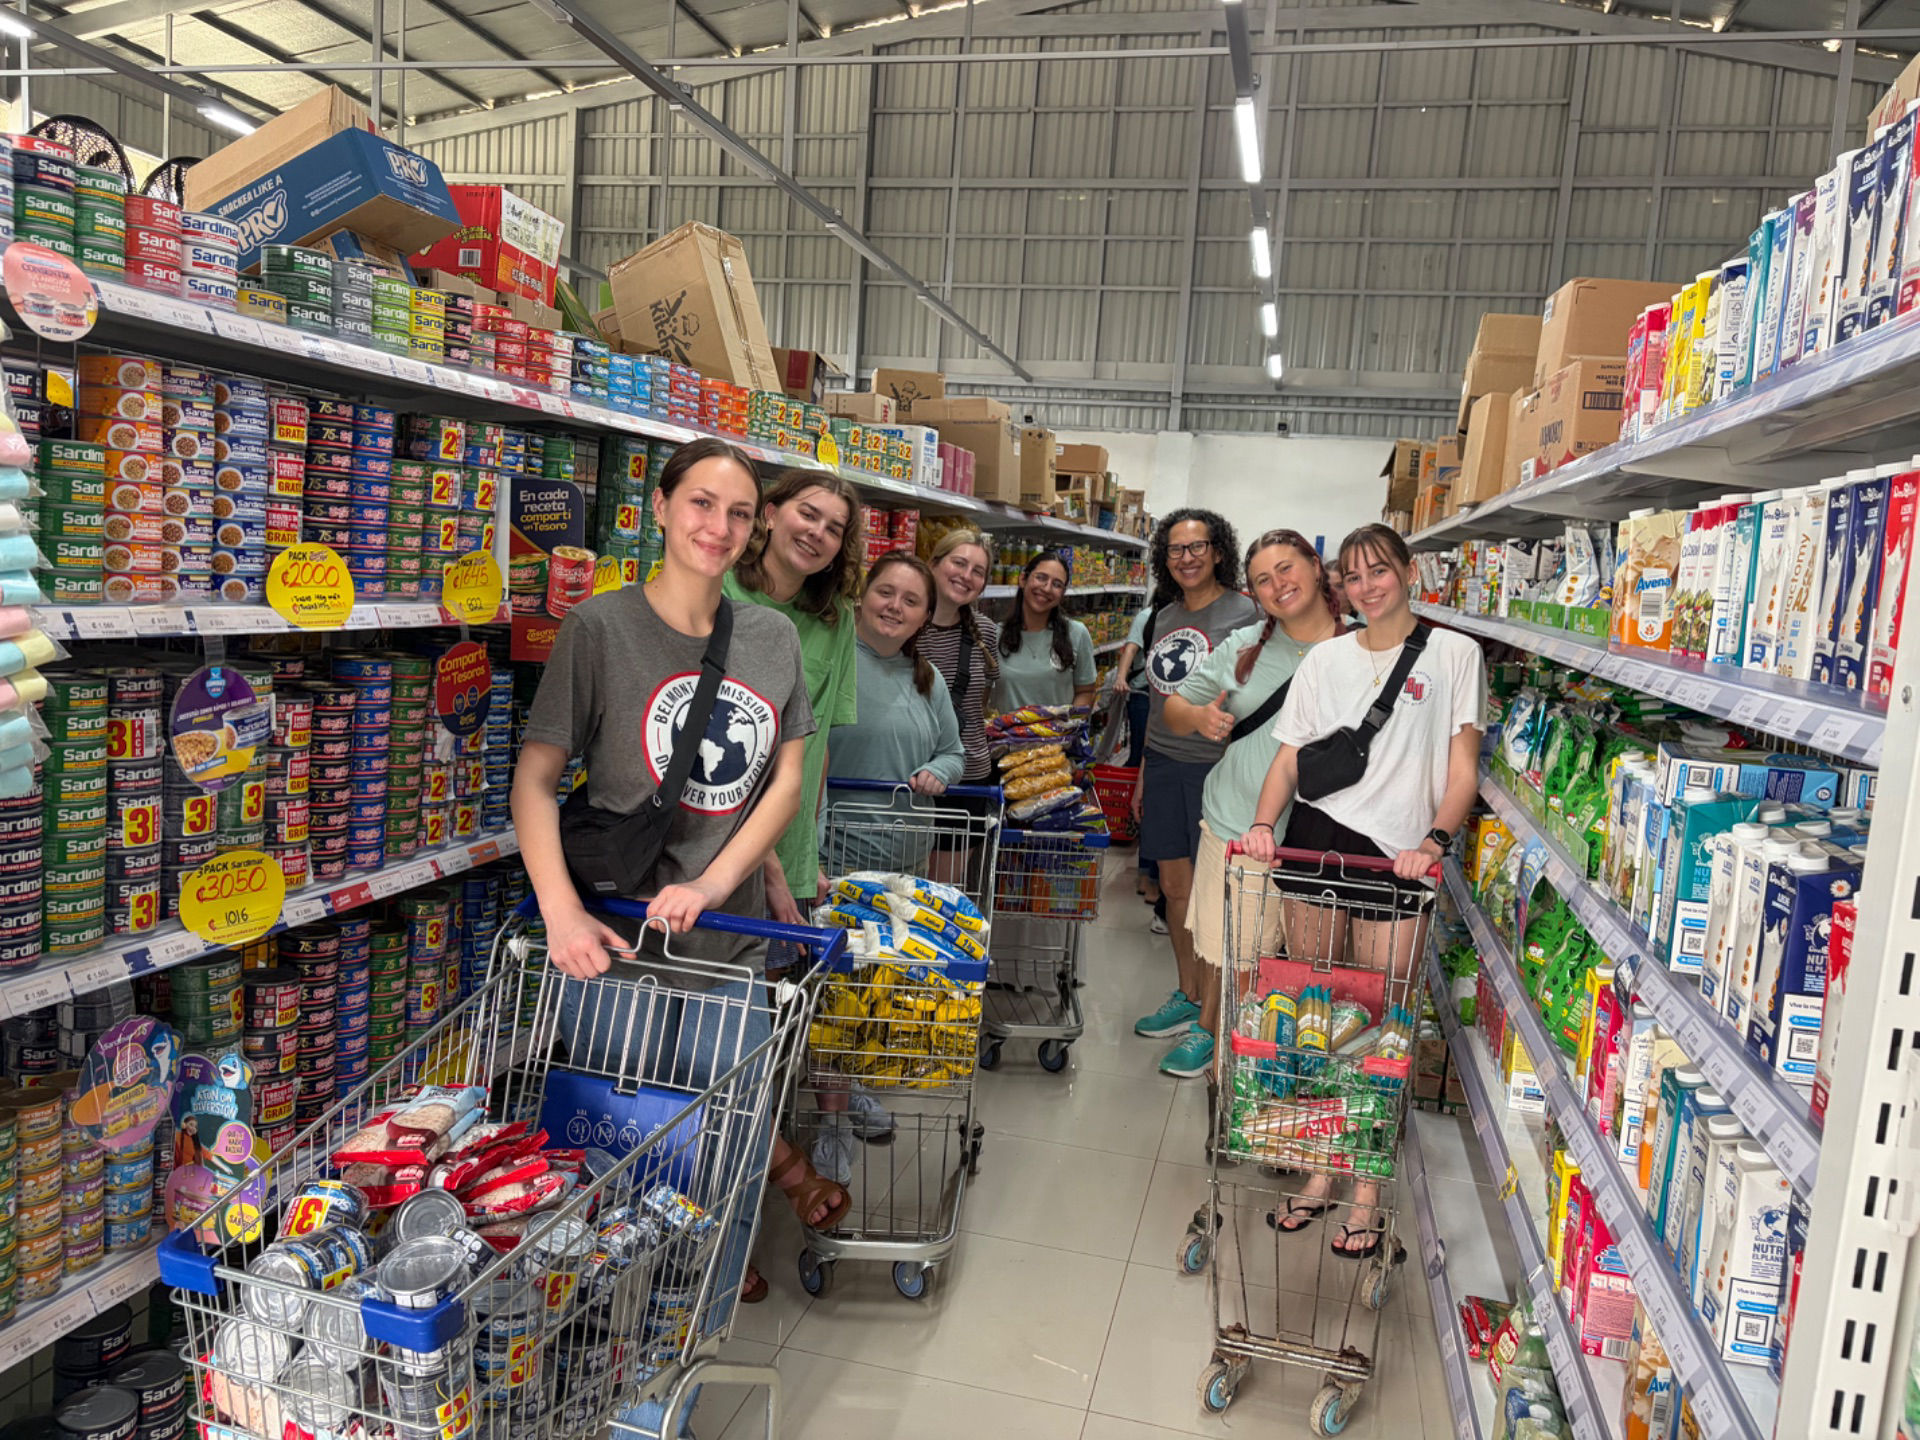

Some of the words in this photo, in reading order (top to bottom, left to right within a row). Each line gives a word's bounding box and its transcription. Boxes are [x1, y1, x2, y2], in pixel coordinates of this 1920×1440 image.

[253, 183, 274, 201] LIKE
[275, 174, 283, 186] A
[182, 216, 238, 239] Sardima
[779, 405, 785, 421] 2
[792, 412, 800, 428] 2
[443, 431, 457, 455] 2
[778, 432, 785, 446] 2
[852, 429, 859, 443] 2
[873, 435, 881, 449] 2
[631, 456, 642, 478] 3
[434, 476, 449, 499] 2
[479, 483, 492, 506] 2
[520, 490, 535, 502] En
[538, 488, 569, 501] cada
[524, 501, 566, 512] receta
[620, 506, 633, 529] 3
[441, 523, 455, 547] 2
[535, 522, 568, 532] Tesoro
[483, 529, 493, 549] 2
[625, 560, 635, 582] 3
[1635, 577, 1672, 594] Avena
[452, 665, 485, 685] Tesoros
[654, 681, 696, 725] BELMONT
[720, 684, 770, 724] MISSION
[107, 720, 127, 757] 3
[432, 775, 443, 799] 2
[472, 766, 480, 788] 2
[709, 786, 744, 807] YOUR
[743, 751, 768, 793] STORY
[247, 785, 262, 818] 3
[129, 808, 150, 845] 3
[188, 799, 208, 833] 3
[459, 809, 472, 832] 2
[428, 818, 441, 843] 2
[45, 867, 105, 884] Sardima
[204, 862, 229, 873] PACK
[47, 897, 104, 914] Sardima
[135, 895, 152, 930] 3
[225, 908, 248, 926] 1016
[429, 922, 441, 944] 3
[295, 1198, 323, 1235] 3
[547, 1274, 571, 1307] 3
[512, 1343, 531, 1384] 3
[444, 1396, 469, 1434] 3
